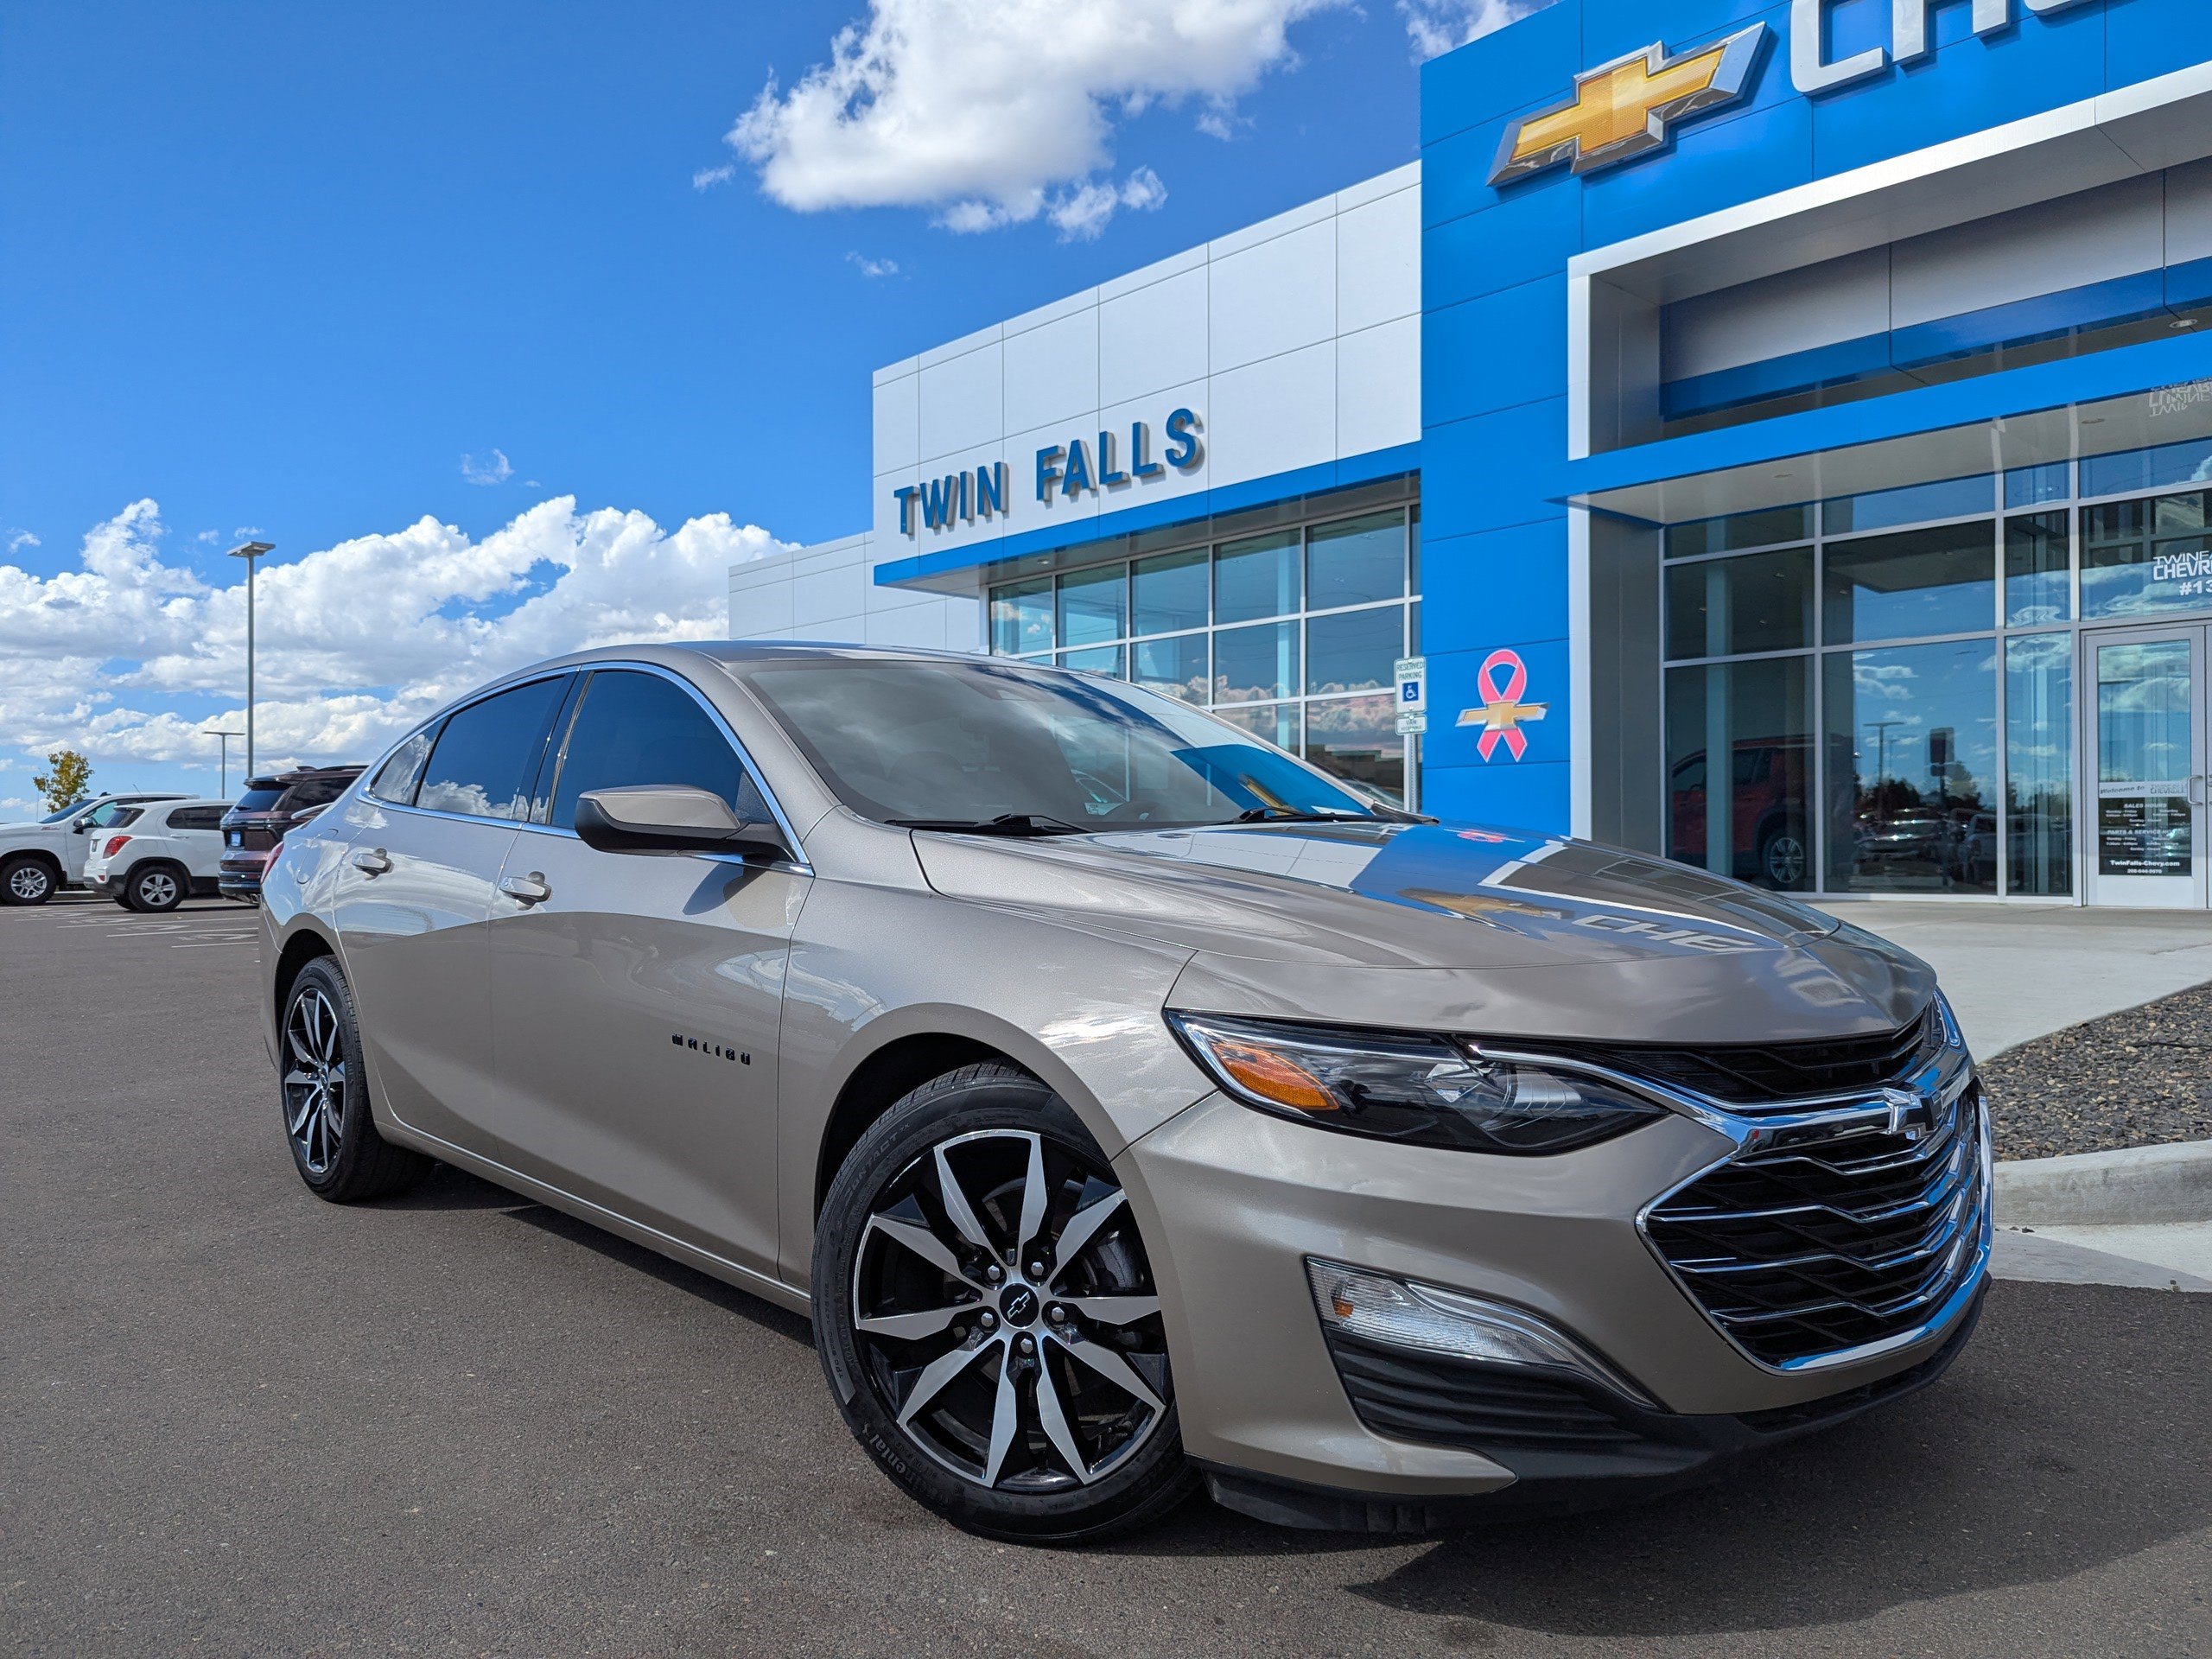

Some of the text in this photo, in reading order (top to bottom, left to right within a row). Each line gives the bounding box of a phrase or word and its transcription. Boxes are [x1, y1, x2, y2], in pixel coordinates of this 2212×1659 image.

[893, 408, 1205, 537] TWIN FALLS
[2153, 550, 2212, 565] TWINF
[2153, 559, 2212, 581] CHEVR
[1396, 662, 1425, 671] RESERVED
[1398, 671, 1422, 680] PARKING
[671, 1033, 751, 1066] MALIBU
